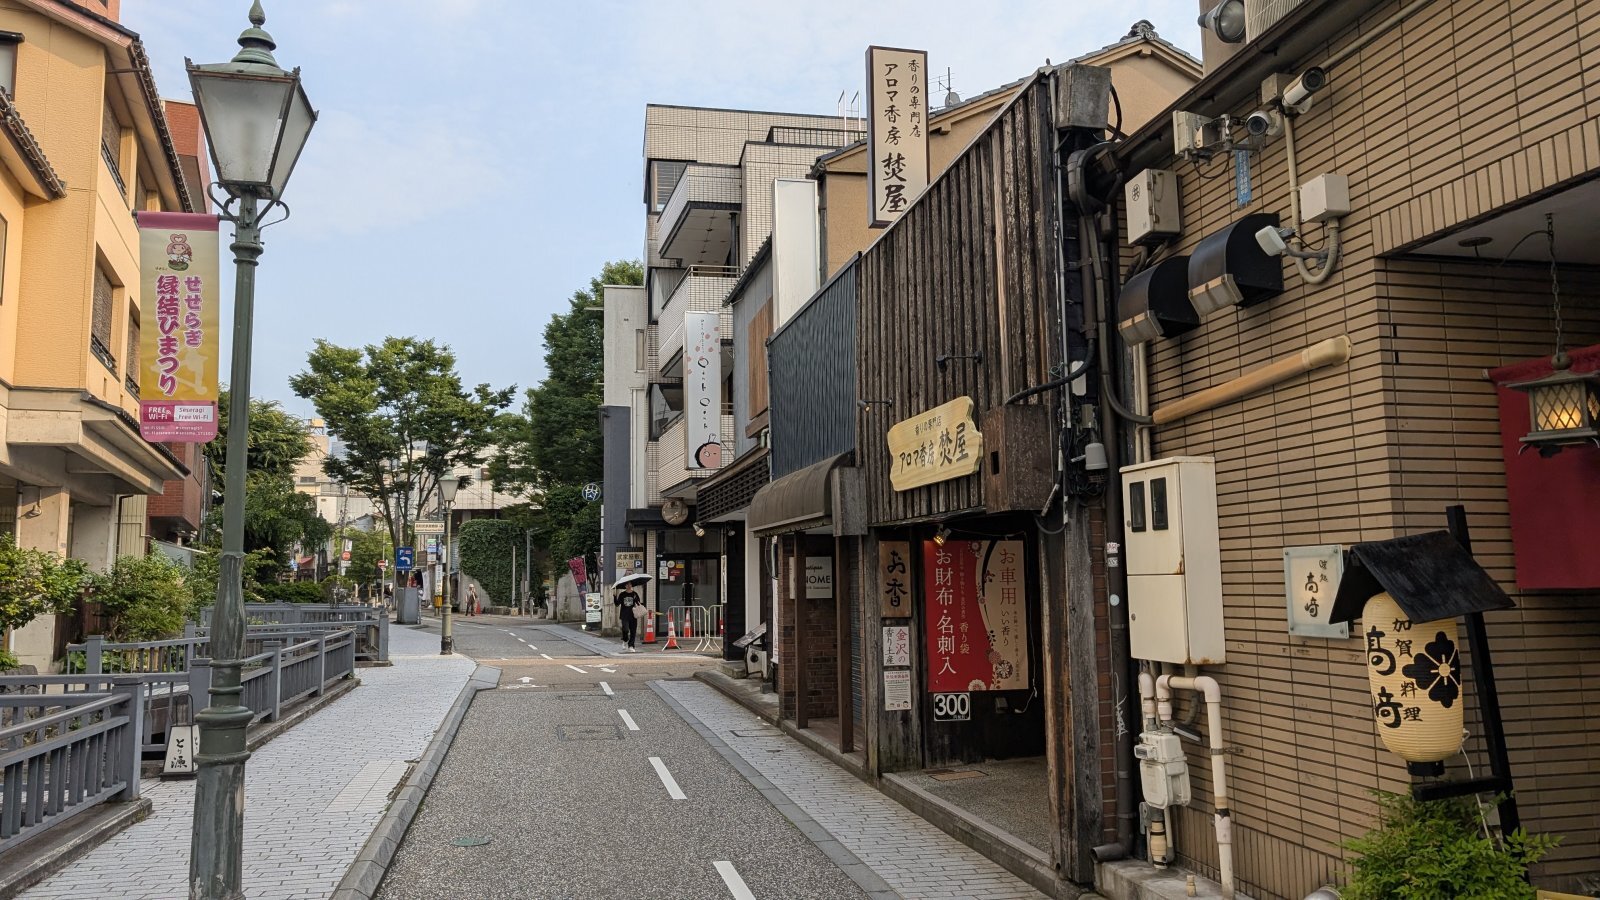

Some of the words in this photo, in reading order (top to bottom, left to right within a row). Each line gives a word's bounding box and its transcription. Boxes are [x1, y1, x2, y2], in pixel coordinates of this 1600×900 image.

[884, 63, 901, 146] アロマ香房
[908, 59, 921, 138] 香りの専門店
[880, 152, 907, 213] 焚屋
[156, 274, 180, 396] 縁結びまつり
[184, 276, 203, 348] せせらぎ
[899, 440, 935, 475] アロマ香房
[939, 421, 969, 467] 焚屋
[885, 551, 908, 608] お香
[1000, 549, 1017, 606] お車用
[935, 549, 957, 676] お財布・名刺入
[959, 622, 970, 655] 香り袋
[1002, 610, 1010, 647] いい香り
[884, 627, 896, 665] 香り土産
[896, 628, 908, 663] 金沢の
[1392, 618, 1424, 722] 加賀料理
[935, 694, 969, 716] 300
